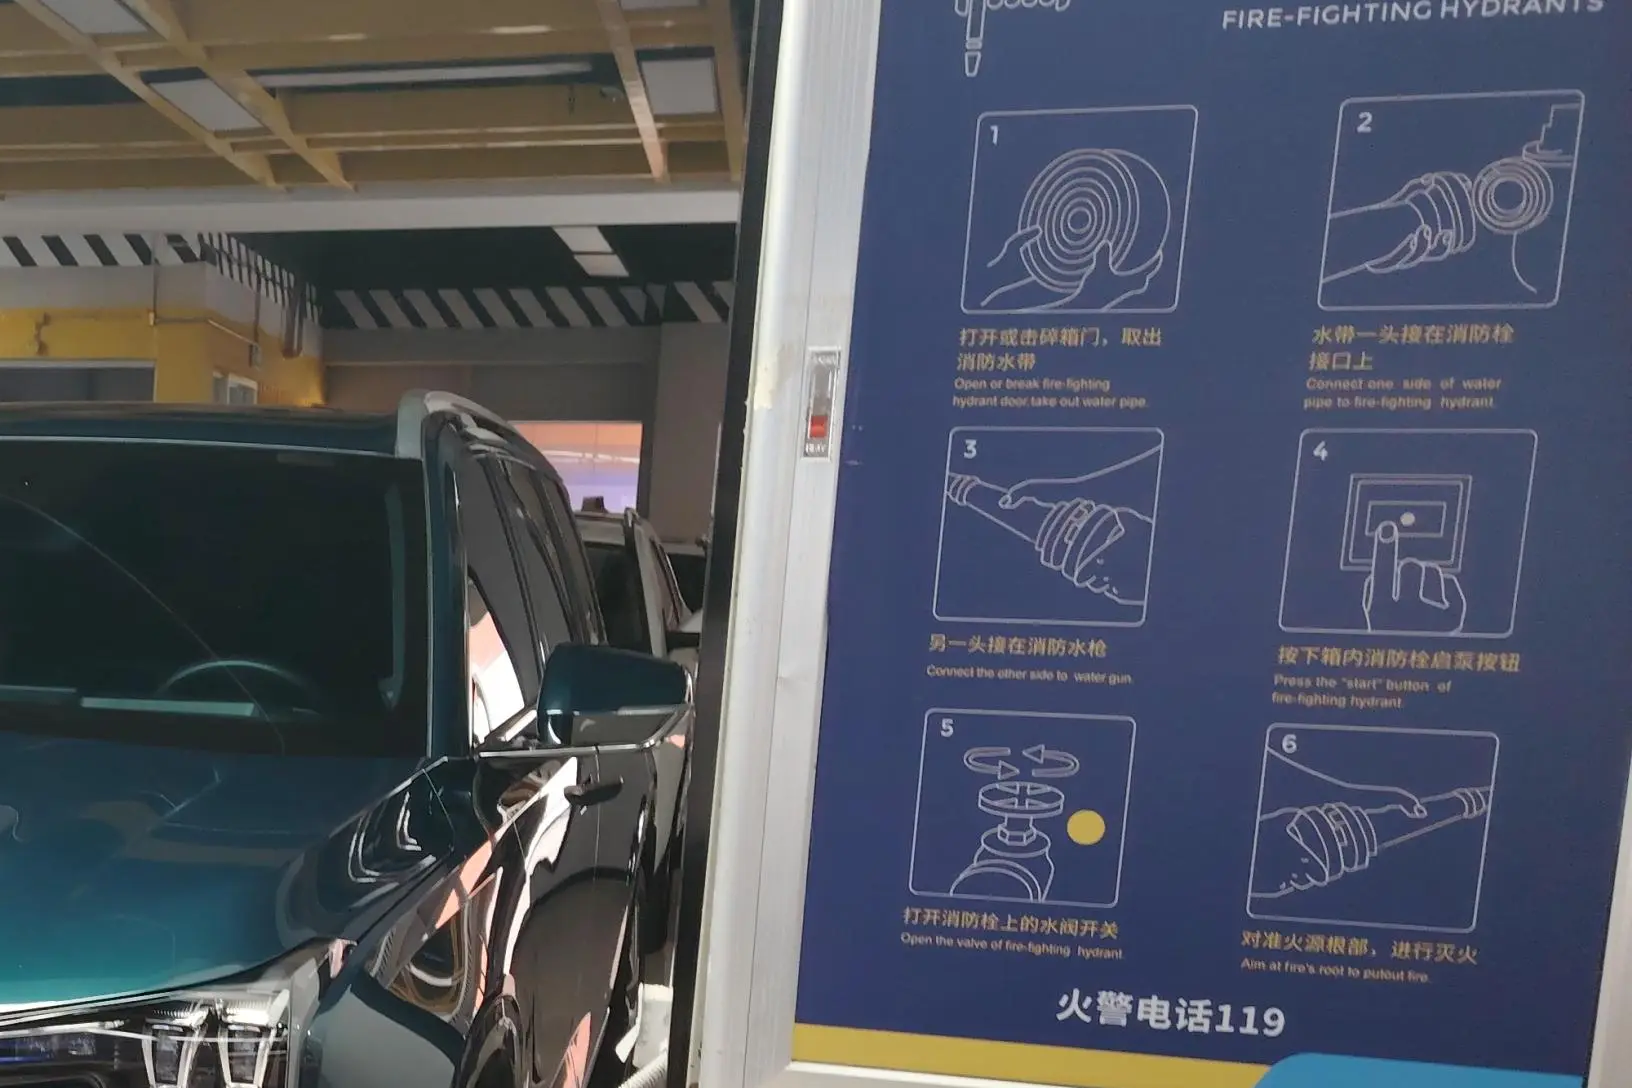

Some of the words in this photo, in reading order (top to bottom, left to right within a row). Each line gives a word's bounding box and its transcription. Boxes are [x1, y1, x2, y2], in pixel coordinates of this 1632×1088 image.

[1222, 1, 1432, 30] FIRE-FIGHTING
[1357, 112, 1374, 133] 2
[989, 125, 999, 146] 1
[1312, 323, 1514, 345] 水带一头接在消防栓
[957, 352, 1036, 371] 消防水带
[1309, 351, 1373, 371] 接口上
[954, 378, 986, 391] Open
[990, 380, 1003, 389] or
[1006, 378, 1040, 389] break
[1306, 377, 1364, 390] Connect
[1368, 380, 1394, 390] one
[1403, 378, 1431, 390] side
[1440, 377, 1455, 390] of
[1463, 378, 1501, 390] water
[953, 395, 998, 409] hydrant
[1059, 397, 1080, 407] out
[1082, 397, 1116, 407] water
[1304, 397, 1332, 410] pipe
[1337, 396, 1350, 407] to
[962, 439, 978, 459] 3
[1312, 441, 1330, 461] 4
[929, 633, 1107, 658] 另一头接在消防水枪
[1278, 645, 1521, 672] 按下箱内消防栓启泵按钮
[927, 664, 974, 677] Connect
[977, 666, 995, 678] the
[997, 668, 1027, 680] other
[1029, 670, 1053, 681] side
[1057, 671, 1067, 681] to
[1074, 672, 1106, 683] water
[1274, 673, 1311, 688] Press
[1316, 675, 1337, 688] the
[1386, 679, 1429, 691] button
[1437, 680, 1452, 693] of
[940, 719, 954, 738] 5
[1281, 734, 1297, 754] 6
[903, 906, 1118, 940] 打开消防栓上的水阀开关
[901, 932, 932, 945] Open
[935, 934, 953, 947] the
[957, 938, 988, 949] valve
[990, 939, 1003, 951] of
[1241, 930, 1478, 965] 对准火源根部，进行灭火
[1241, 957, 1266, 970] Aim
[1269, 960, 1281, 971] at
[1319, 964, 1344, 976] root
[1348, 967, 1361, 978] to
[1056, 987, 1286, 1038] 火警电话119
